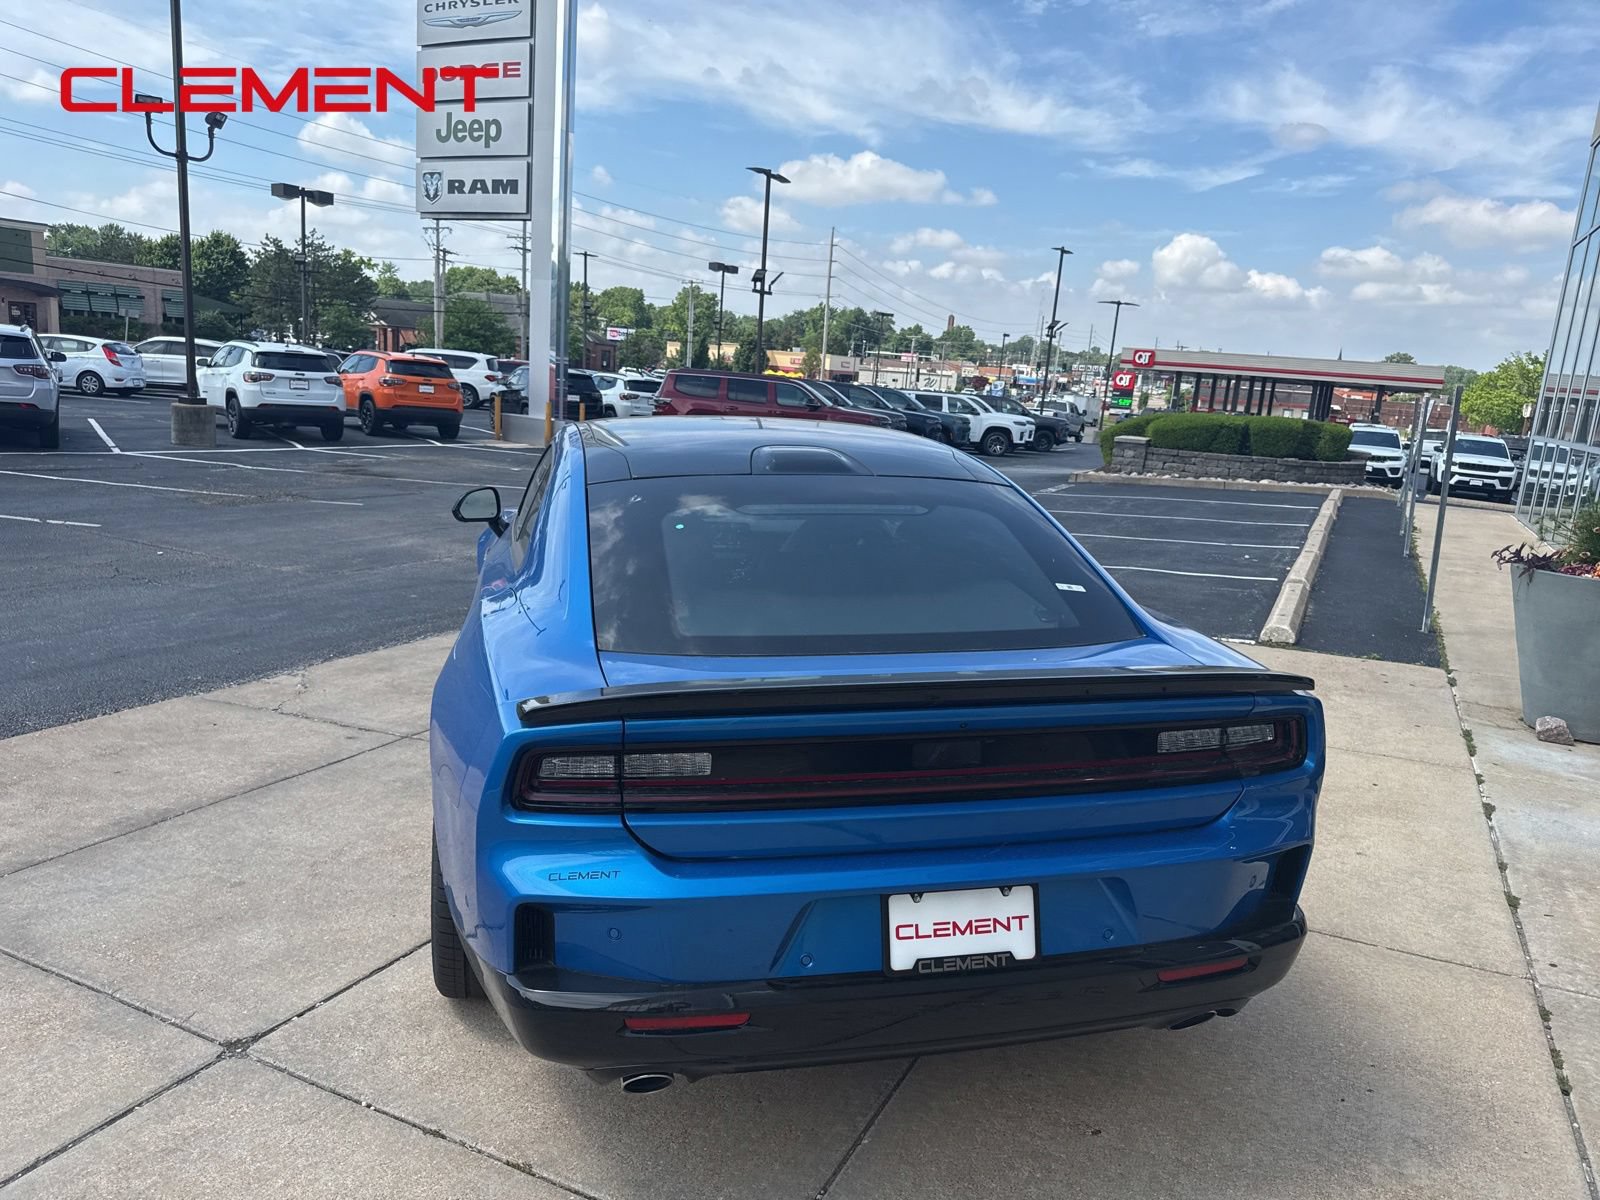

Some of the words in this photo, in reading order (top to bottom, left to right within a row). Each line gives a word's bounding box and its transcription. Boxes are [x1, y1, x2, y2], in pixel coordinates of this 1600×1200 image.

[436, 112, 502, 148] Jeep
[447, 179, 519, 194] RAM
[1135, 351, 1152, 364] QT
[1115, 374, 1132, 387] QT
[548, 870, 622, 882] CLEMENT
[895, 914, 1030, 941] CLEMENT
[918, 953, 1011, 974] CLEMENT
